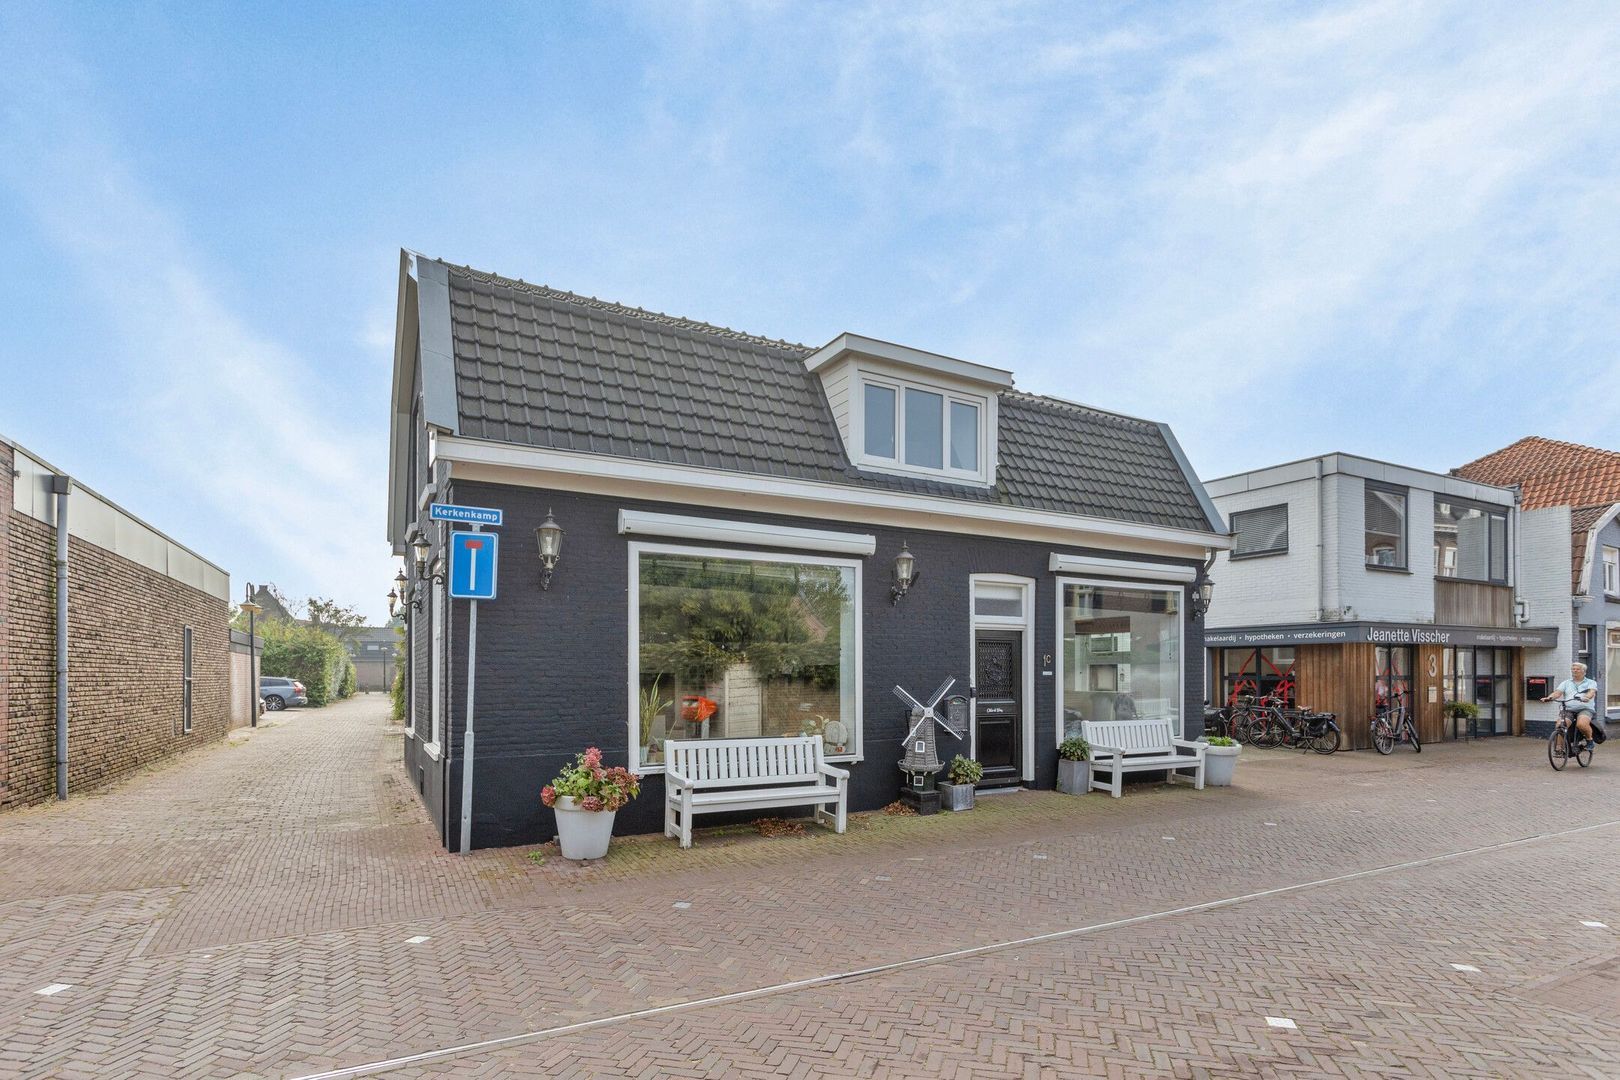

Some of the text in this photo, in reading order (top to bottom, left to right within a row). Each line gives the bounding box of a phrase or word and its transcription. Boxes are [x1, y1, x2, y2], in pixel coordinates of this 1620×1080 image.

[435, 507, 498, 521] Kerkenkamp
[1244, 633, 1285, 642] hypotheken
[1293, 630, 1346, 639] verzekeringen
[1367, 627, 1450, 643] Jeanette Visscher
[1428, 654, 1437, 678] 3
